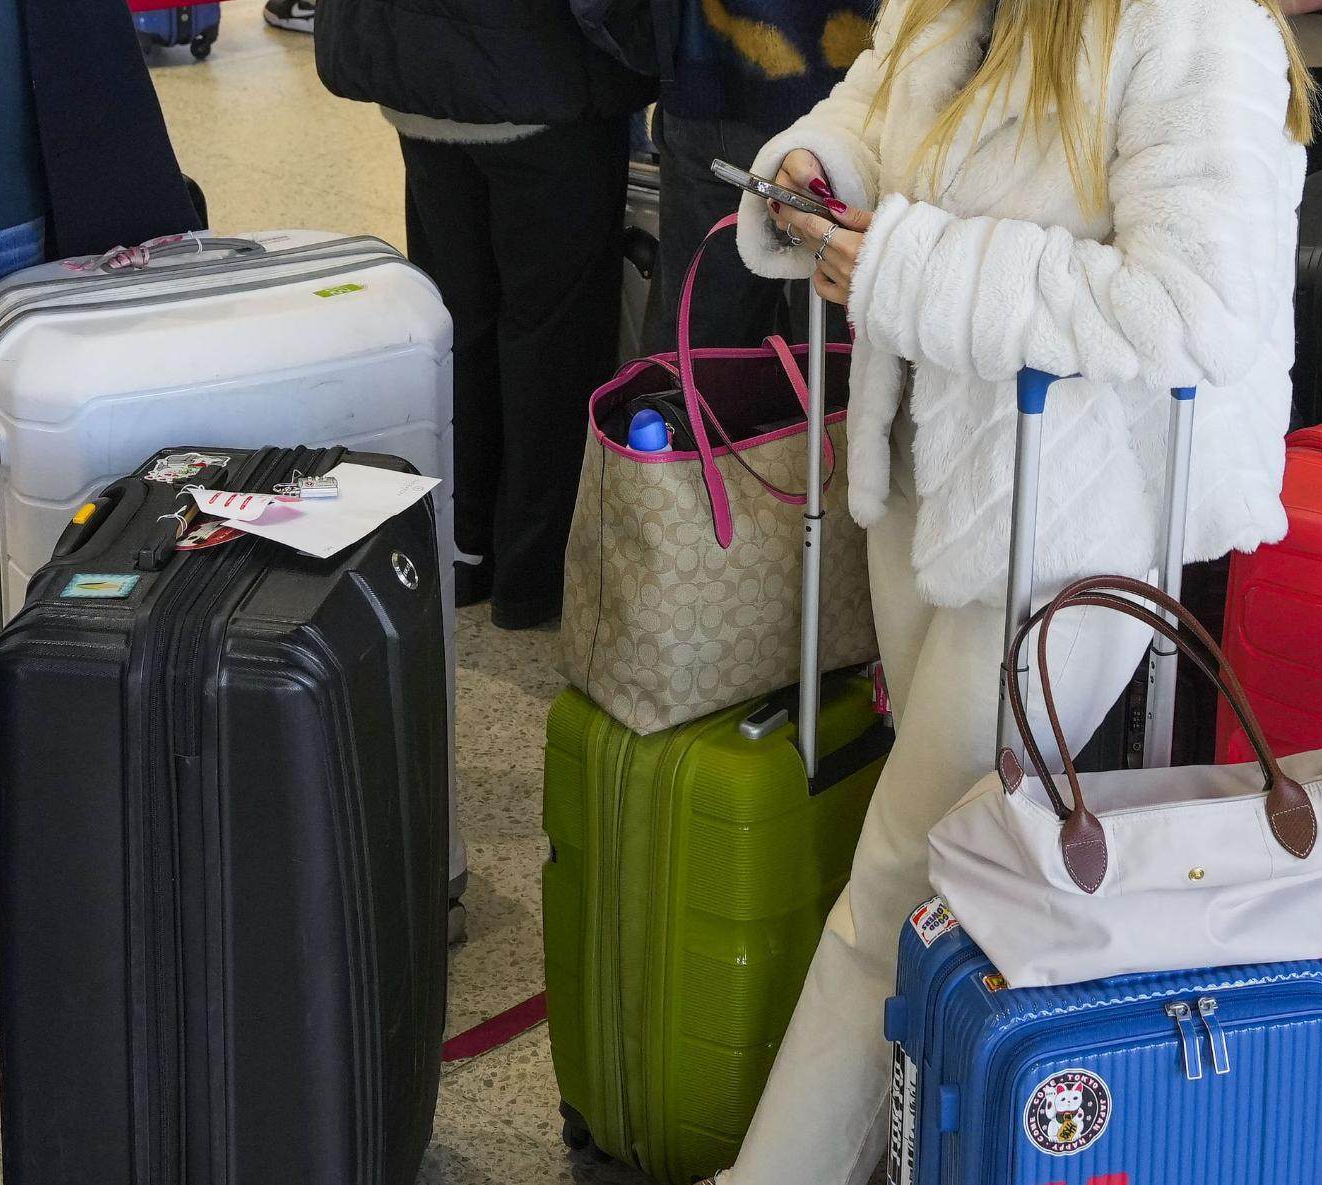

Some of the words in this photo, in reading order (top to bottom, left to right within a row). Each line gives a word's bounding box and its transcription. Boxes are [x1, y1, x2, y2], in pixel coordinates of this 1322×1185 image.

[921, 903, 946, 931] LOWERS
[929, 913, 949, 931] GOOD
[1067, 1074, 1099, 1089] TOKYO
[1092, 1098, 1107, 1131] JAPAN
[1029, 1116, 1044, 1142] COME
[1051, 1137, 1086, 1151] HAPPY
